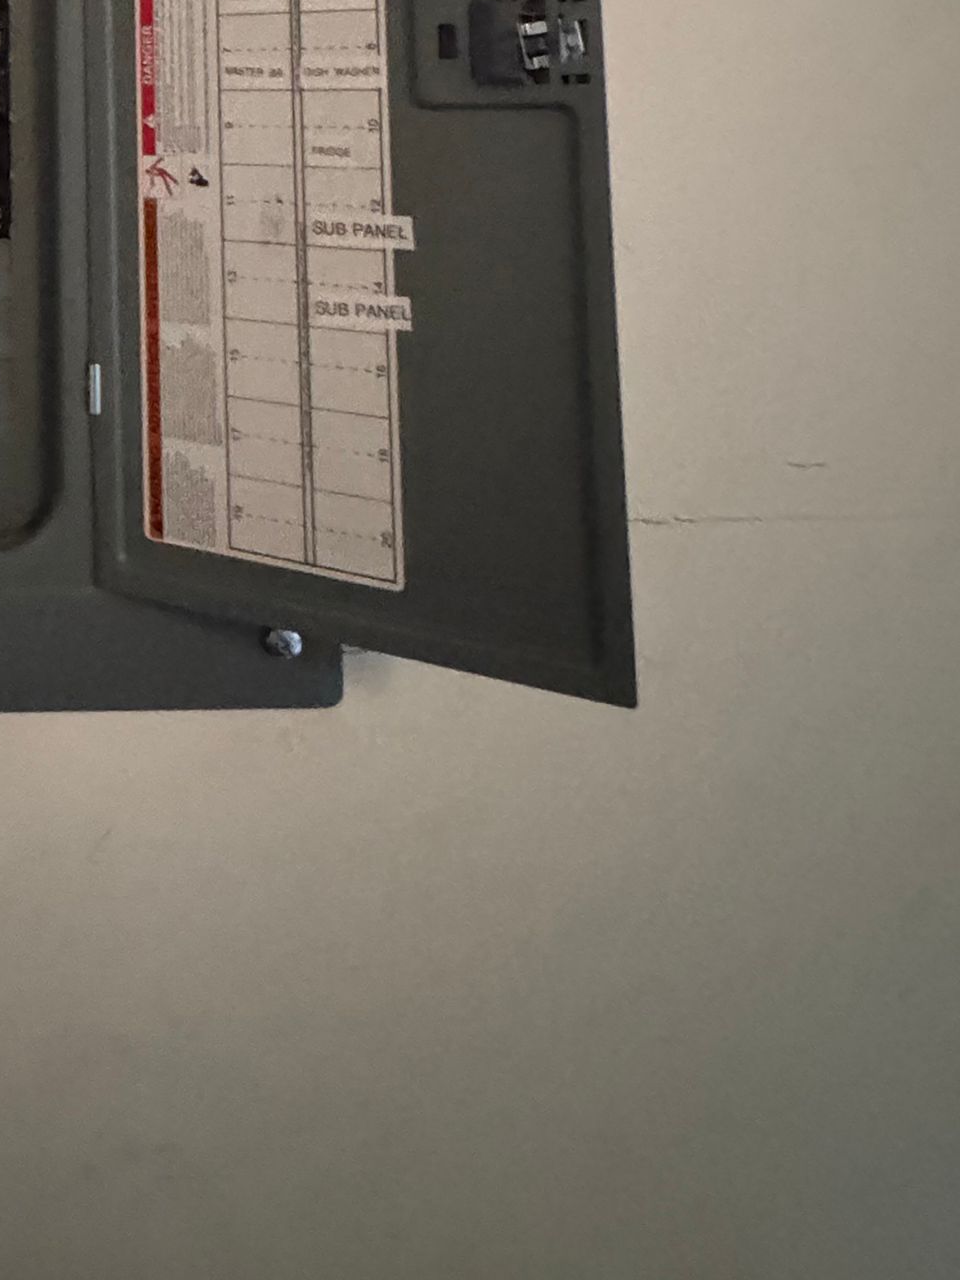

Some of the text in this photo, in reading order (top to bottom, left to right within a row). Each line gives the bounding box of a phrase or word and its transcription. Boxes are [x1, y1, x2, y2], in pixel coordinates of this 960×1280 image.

[142, 24, 153, 85] DANGER
[368, 117, 379, 133] 10
[371, 198, 382, 213] 12
[311, 220, 408, 240] SUB PANEL
[314, 300, 412, 321] SUB PANEL
